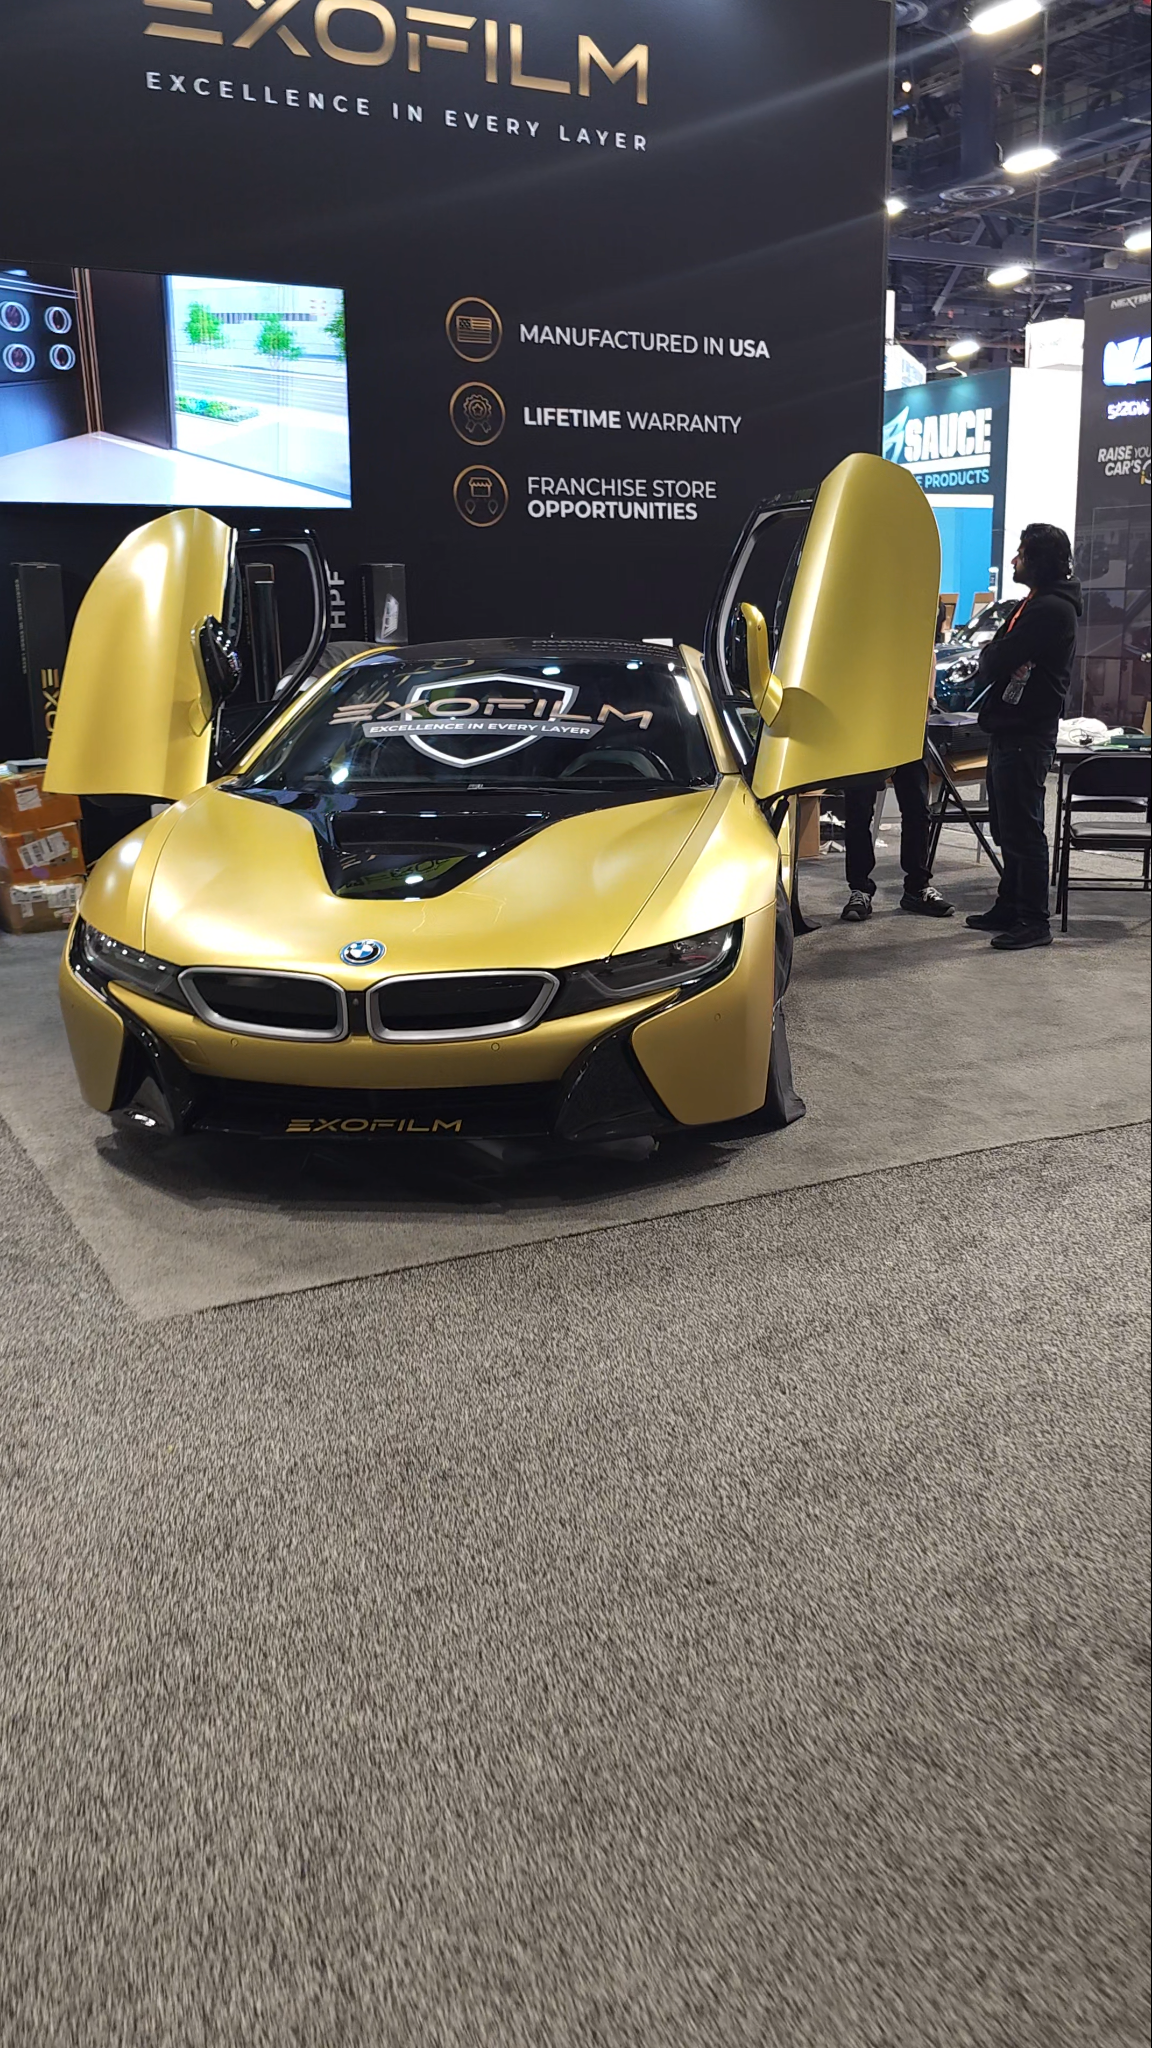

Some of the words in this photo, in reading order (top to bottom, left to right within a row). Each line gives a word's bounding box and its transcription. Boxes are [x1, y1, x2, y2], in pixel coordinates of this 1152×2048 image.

[143, 0, 649, 105] EXOFILM
[145, 71, 370, 116] EXCELLENCE
[392, 102, 423, 123] IN
[445, 109, 540, 138] EVERY
[559, 124, 648, 152] LAYER
[519, 323, 699, 354] MANUFACTURED
[703, 336, 724, 356] IN
[729, 338, 771, 359] USA
[523, 406, 622, 429] LIFETIME
[626, 410, 742, 434] WARRANTY
[904, 407, 992, 462] SAUCE
[1098, 445, 1133, 463] RAISE
[924, 469, 990, 488] PRODUCTS
[1105, 459, 1142, 476] CAR'S
[527, 476, 648, 498] FRANCHISE
[652, 479, 717, 499] STORE
[527, 499, 698, 521] OPPORTUNITIES
[329, 697, 653, 730] EXOFILM
[369, 722, 464, 734] EXCELLENCE
[467, 722, 485, 731] IN
[489, 722, 538, 732] EVERY
[541, 723, 591, 735] LAYER
[285, 1118, 463, 1133] EXOFILM
